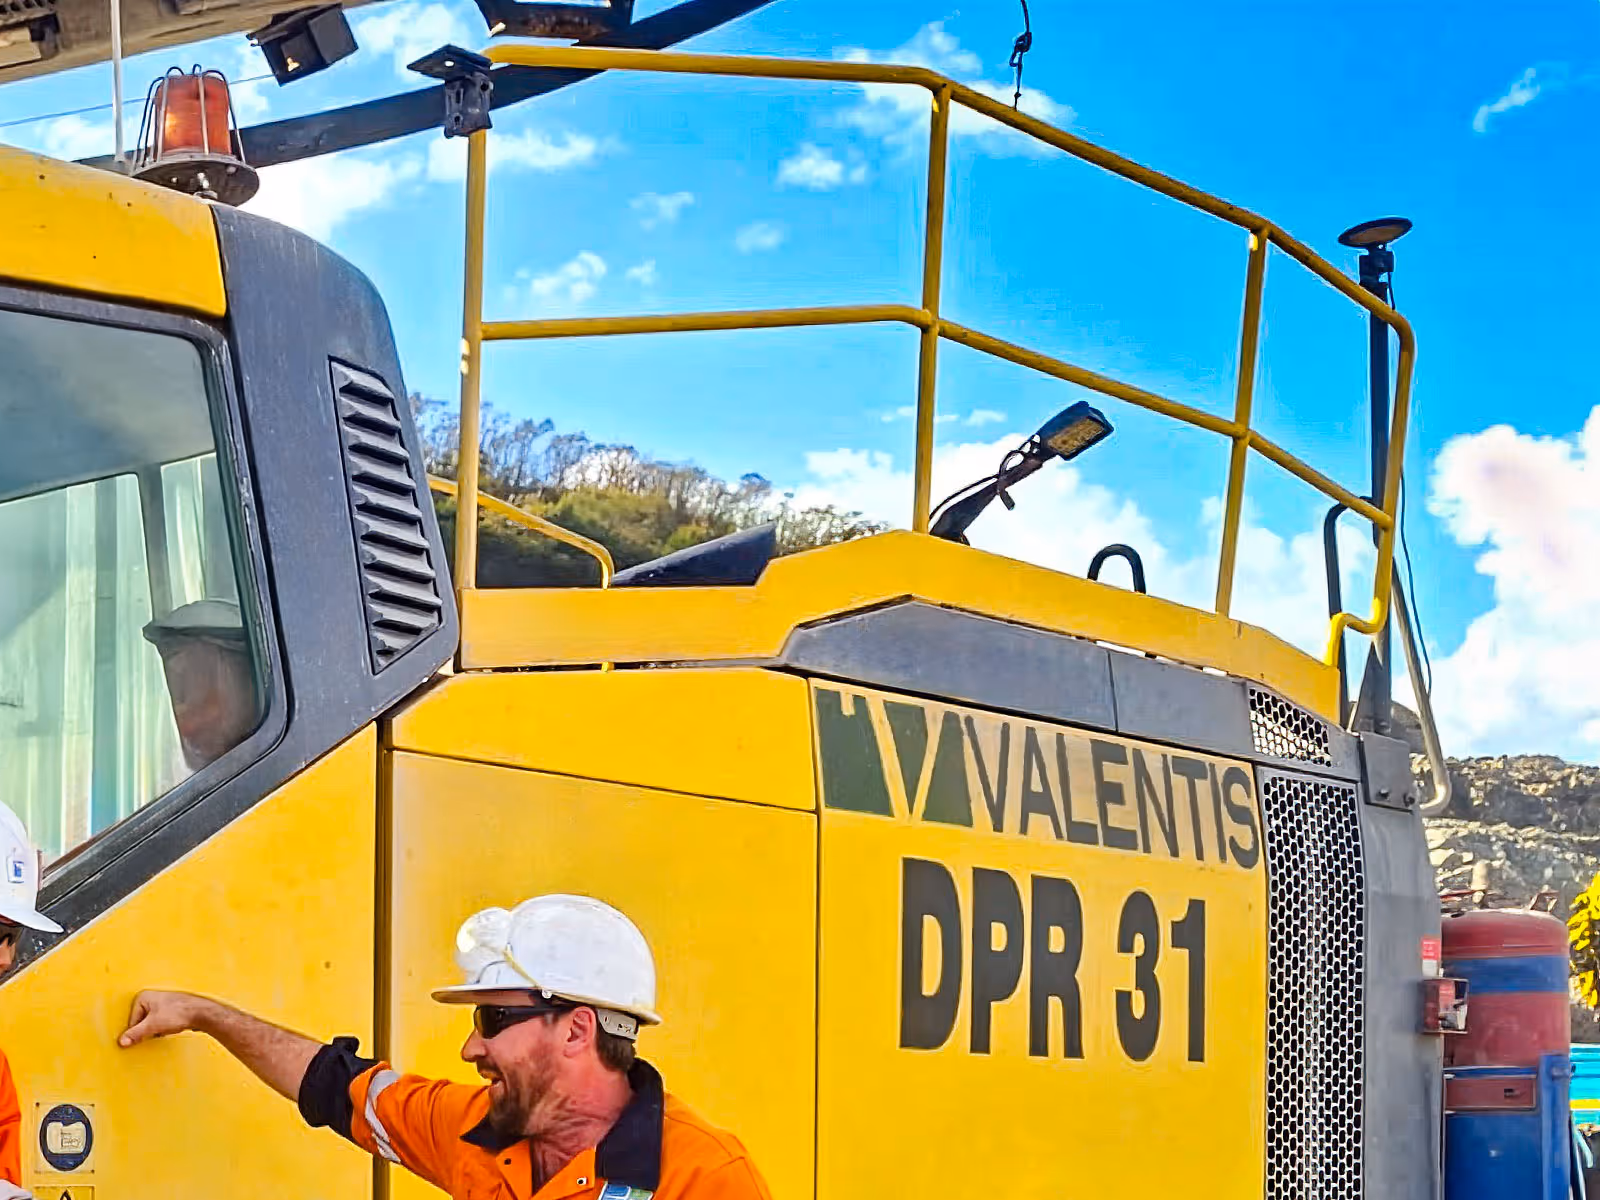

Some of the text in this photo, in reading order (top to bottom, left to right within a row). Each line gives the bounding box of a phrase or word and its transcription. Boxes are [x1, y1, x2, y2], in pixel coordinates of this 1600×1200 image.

[963, 714, 1260, 869] VALENTIS
[900, 857, 1206, 1062] DPR 31
